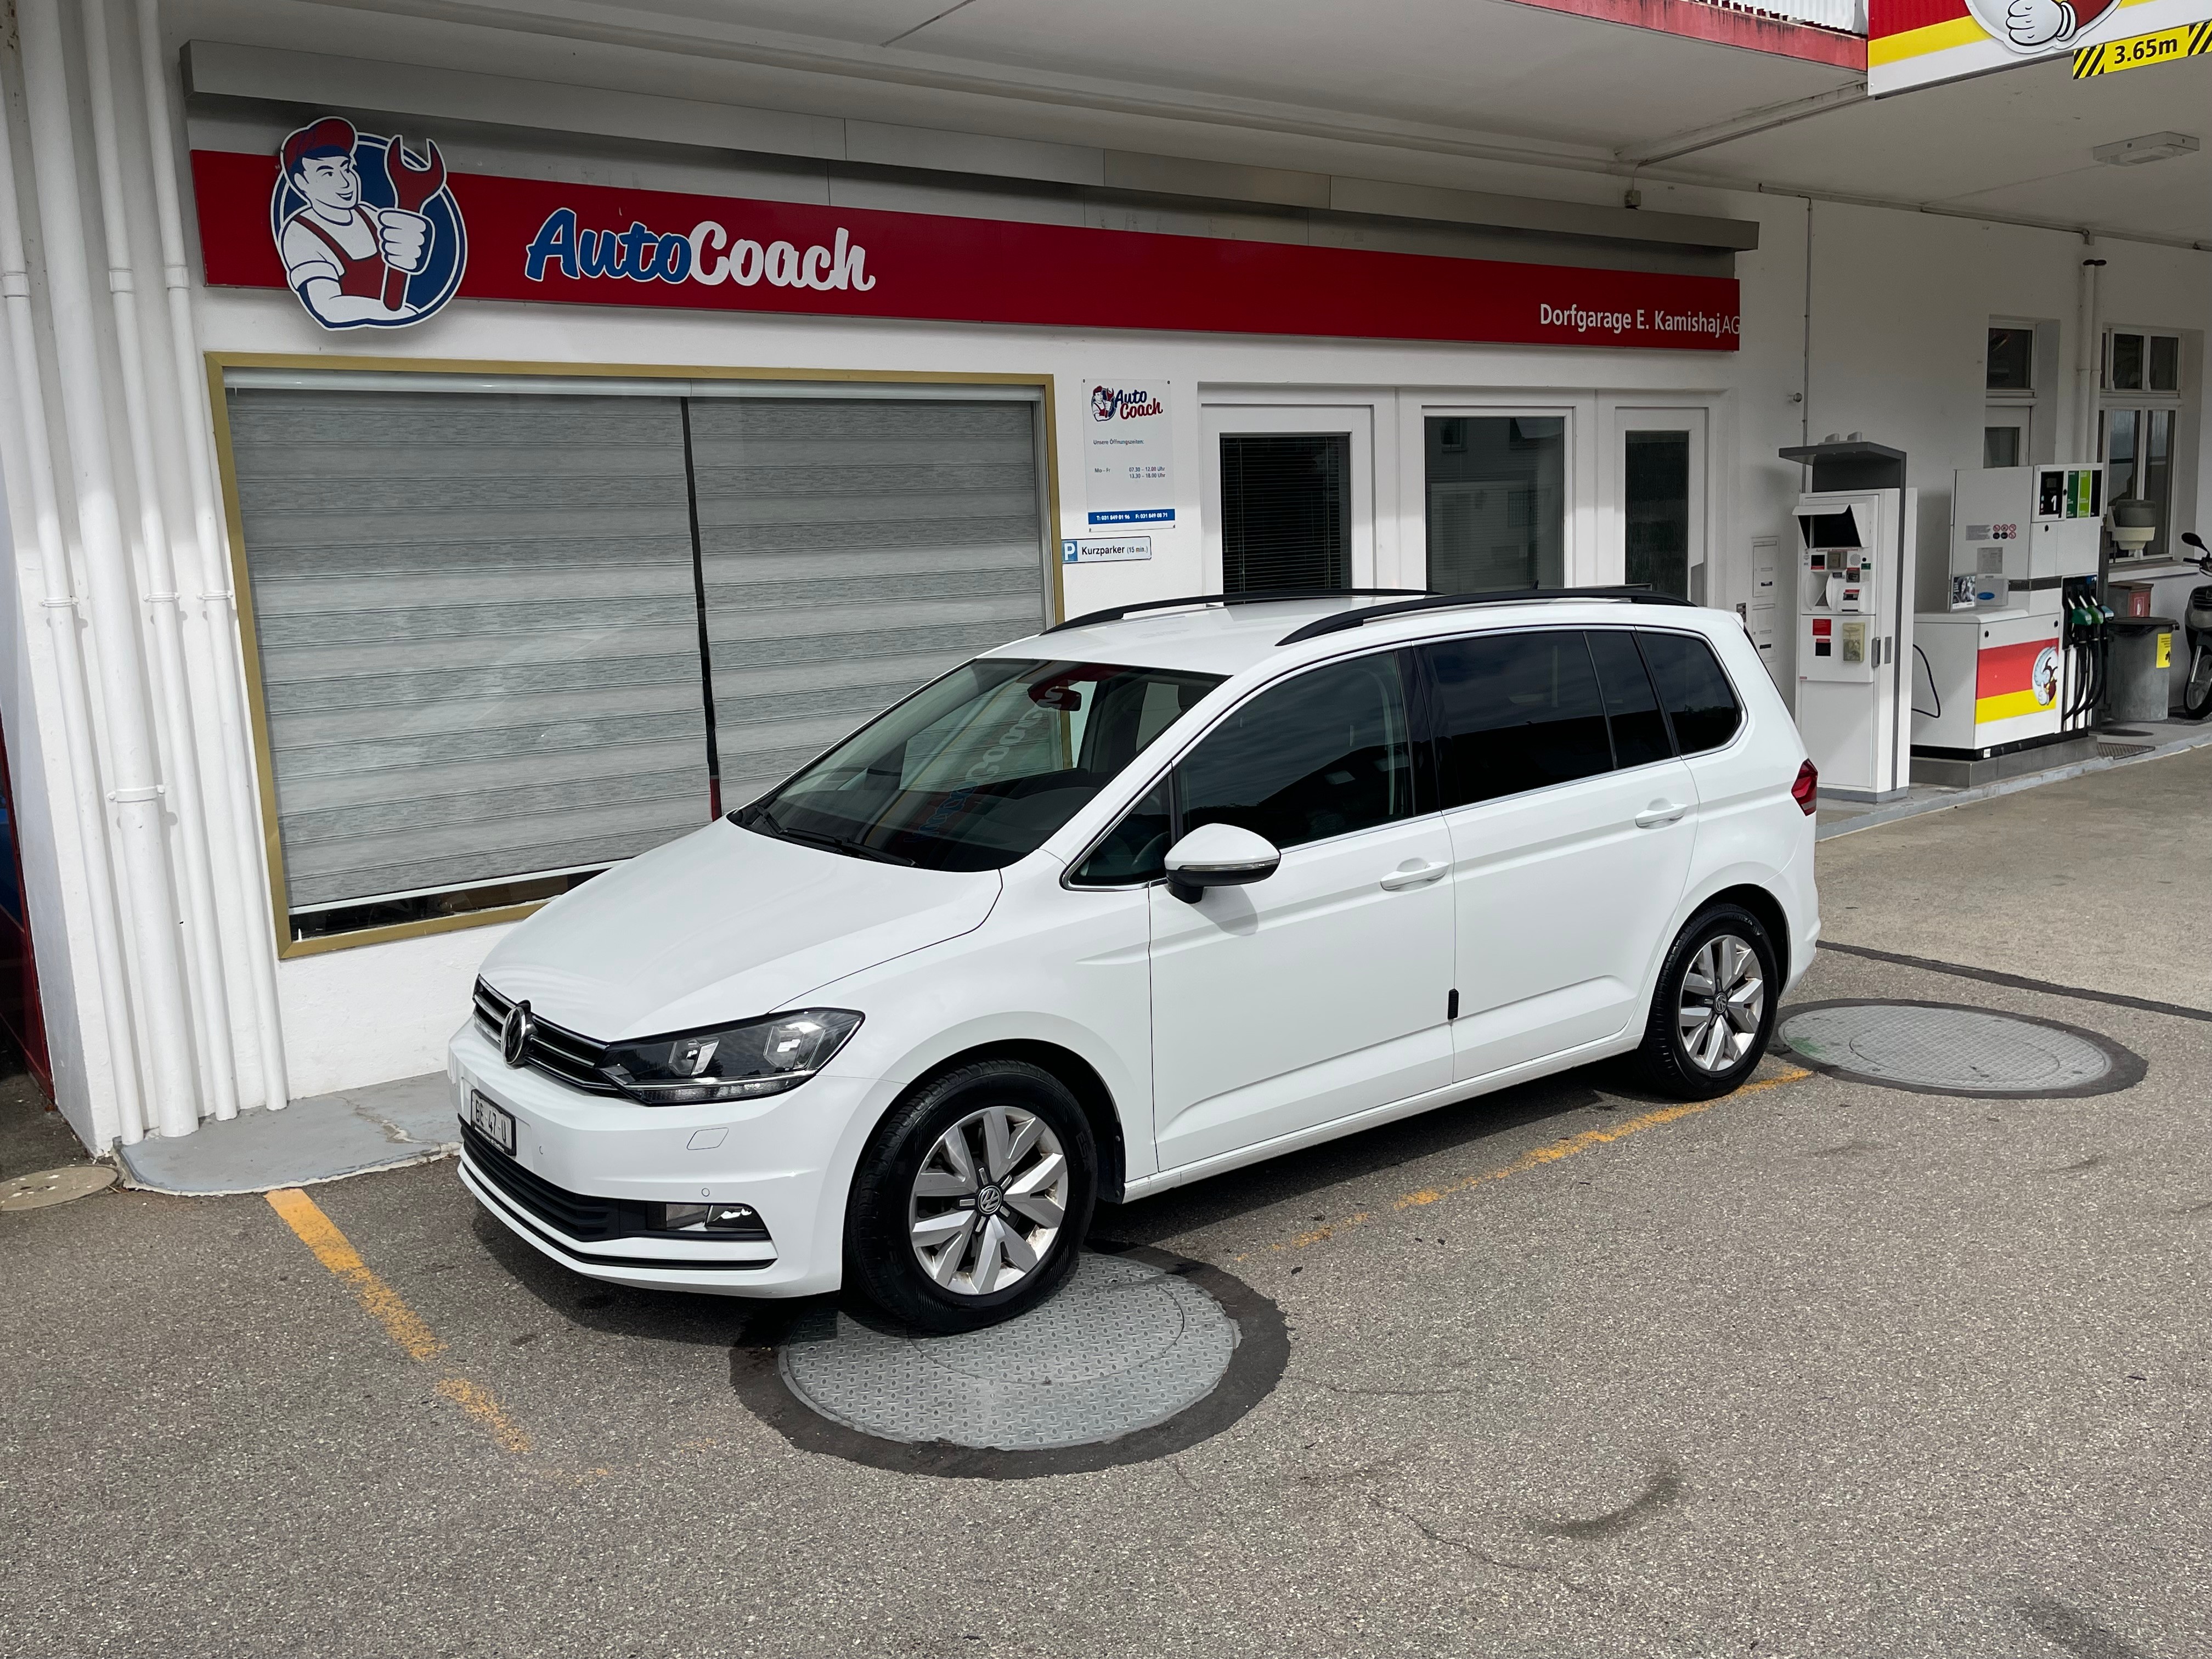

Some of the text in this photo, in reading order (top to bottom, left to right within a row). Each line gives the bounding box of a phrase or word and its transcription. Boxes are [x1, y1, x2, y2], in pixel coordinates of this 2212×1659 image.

[2114, 38, 2177, 64] 3.65m
[525, 207, 876, 291] AutoCoach
[1541, 303, 1632, 334] Dorfgarage
[1637, 309, 1649, 329] E.
[1655, 310, 1720, 338] Kamishaj
[1114, 389, 1147, 408] Auto
[1120, 398, 1164, 420] Coach
[2051, 495, 2057, 511] 1
[1082, 545, 1125, 556] Kurzparker
